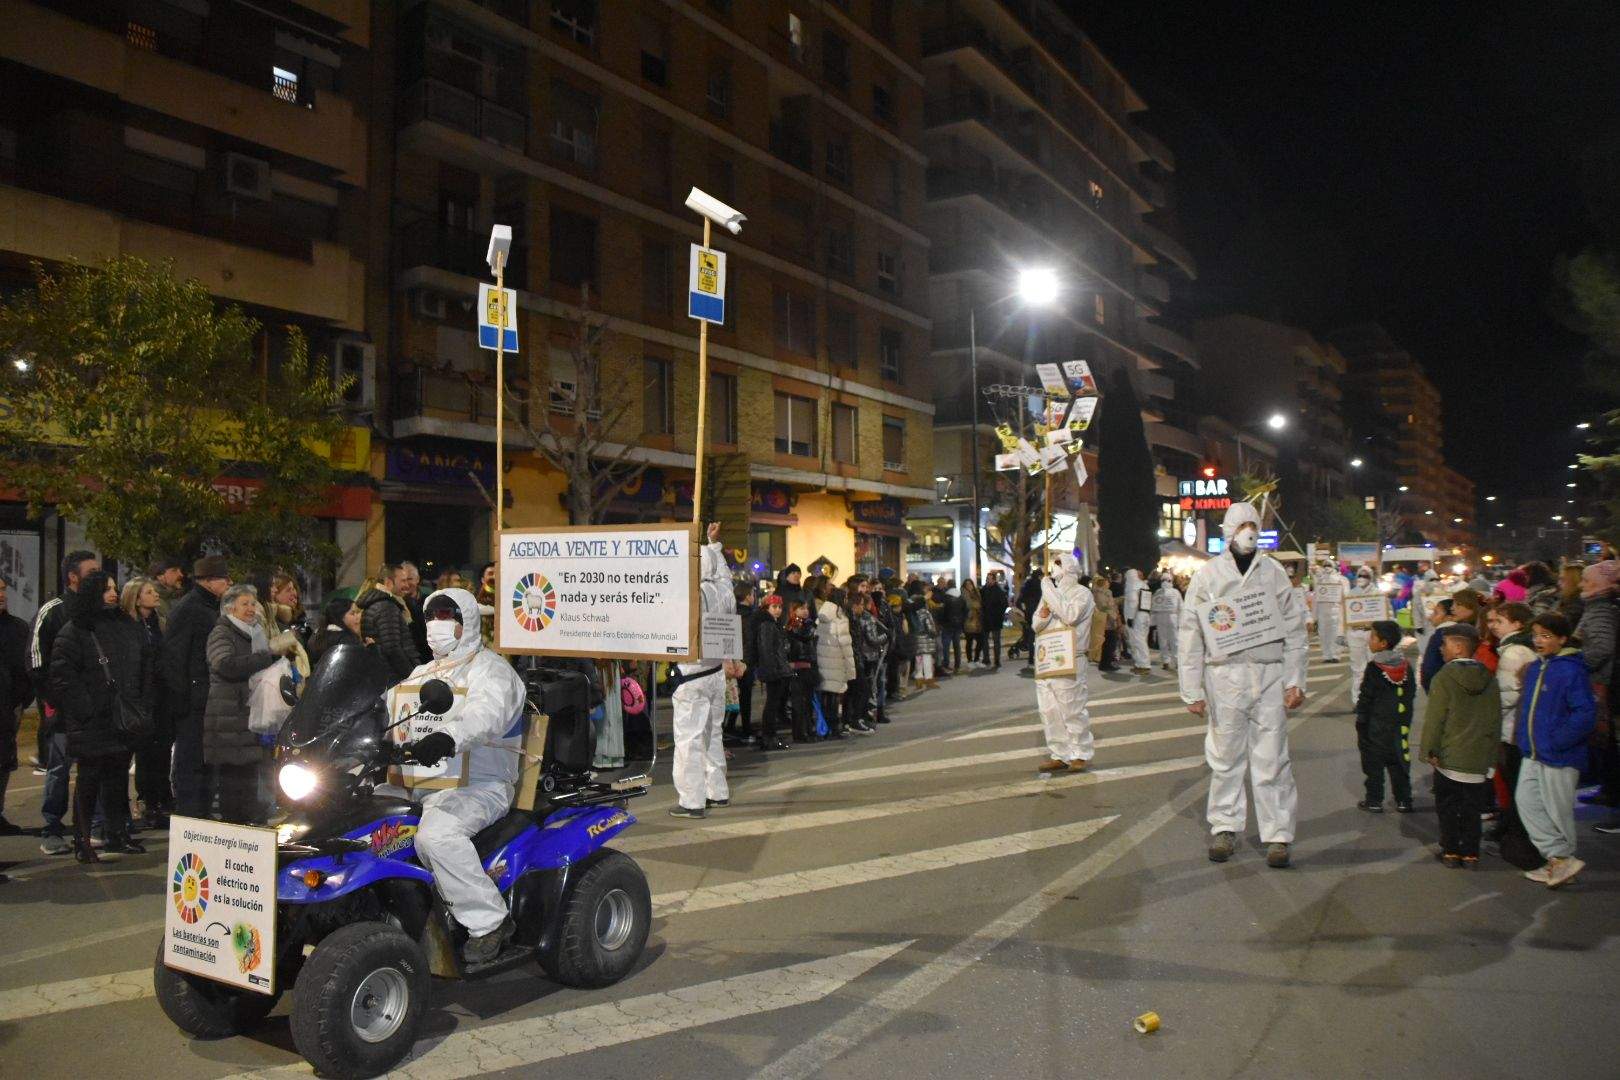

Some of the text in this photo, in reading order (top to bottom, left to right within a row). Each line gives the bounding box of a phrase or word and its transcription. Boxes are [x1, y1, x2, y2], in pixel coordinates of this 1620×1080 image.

[1195, 479, 1228, 496] BAR
[509, 539, 679, 558] AGENDA VENTE Y TRINCA
[558, 571, 669, 584] "En 2030 no tendrás
[560, 591, 664, 606] nada y serás feliz".
[560, 612, 610, 622] Klaus Schwab
[559, 629, 678, 641] Presidente del Foro Económico Mundial
[183, 829, 259, 853] Objetivos: Energía limpia
[225, 859, 254, 874] El coche
[216, 875, 260, 893] eléctrico no
[213, 894, 263, 912] es la solución
[172, 927, 220, 948] Las baterías son
[172, 942, 217, 962] contaminación
